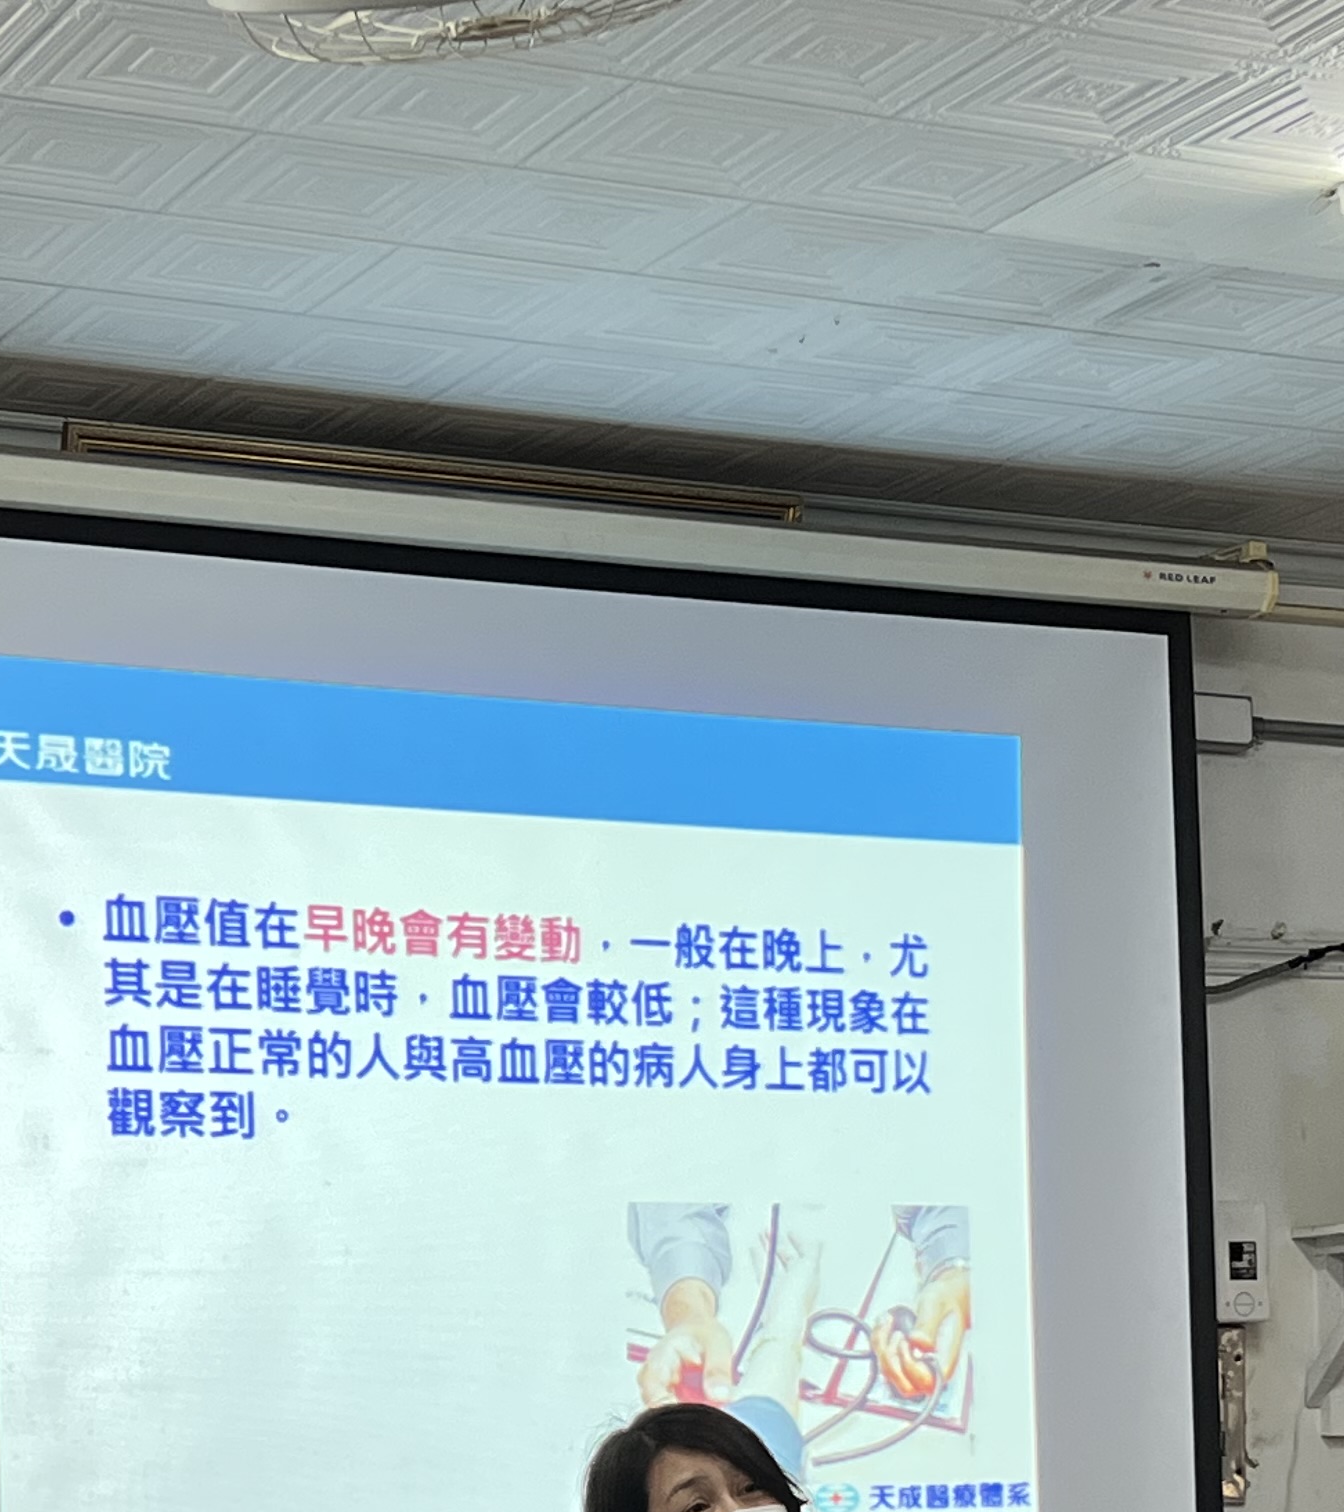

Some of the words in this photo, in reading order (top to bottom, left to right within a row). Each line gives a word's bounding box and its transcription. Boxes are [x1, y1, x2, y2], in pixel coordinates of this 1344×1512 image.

[1159, 572, 1183, 582] RED
[1186, 575, 1216, 584] LEAF
[107, 1024, 931, 1095] 血壓正常的人與高血壓的病人身上都可以
[869, 1482, 1031, 1510] 天成醫療體系
